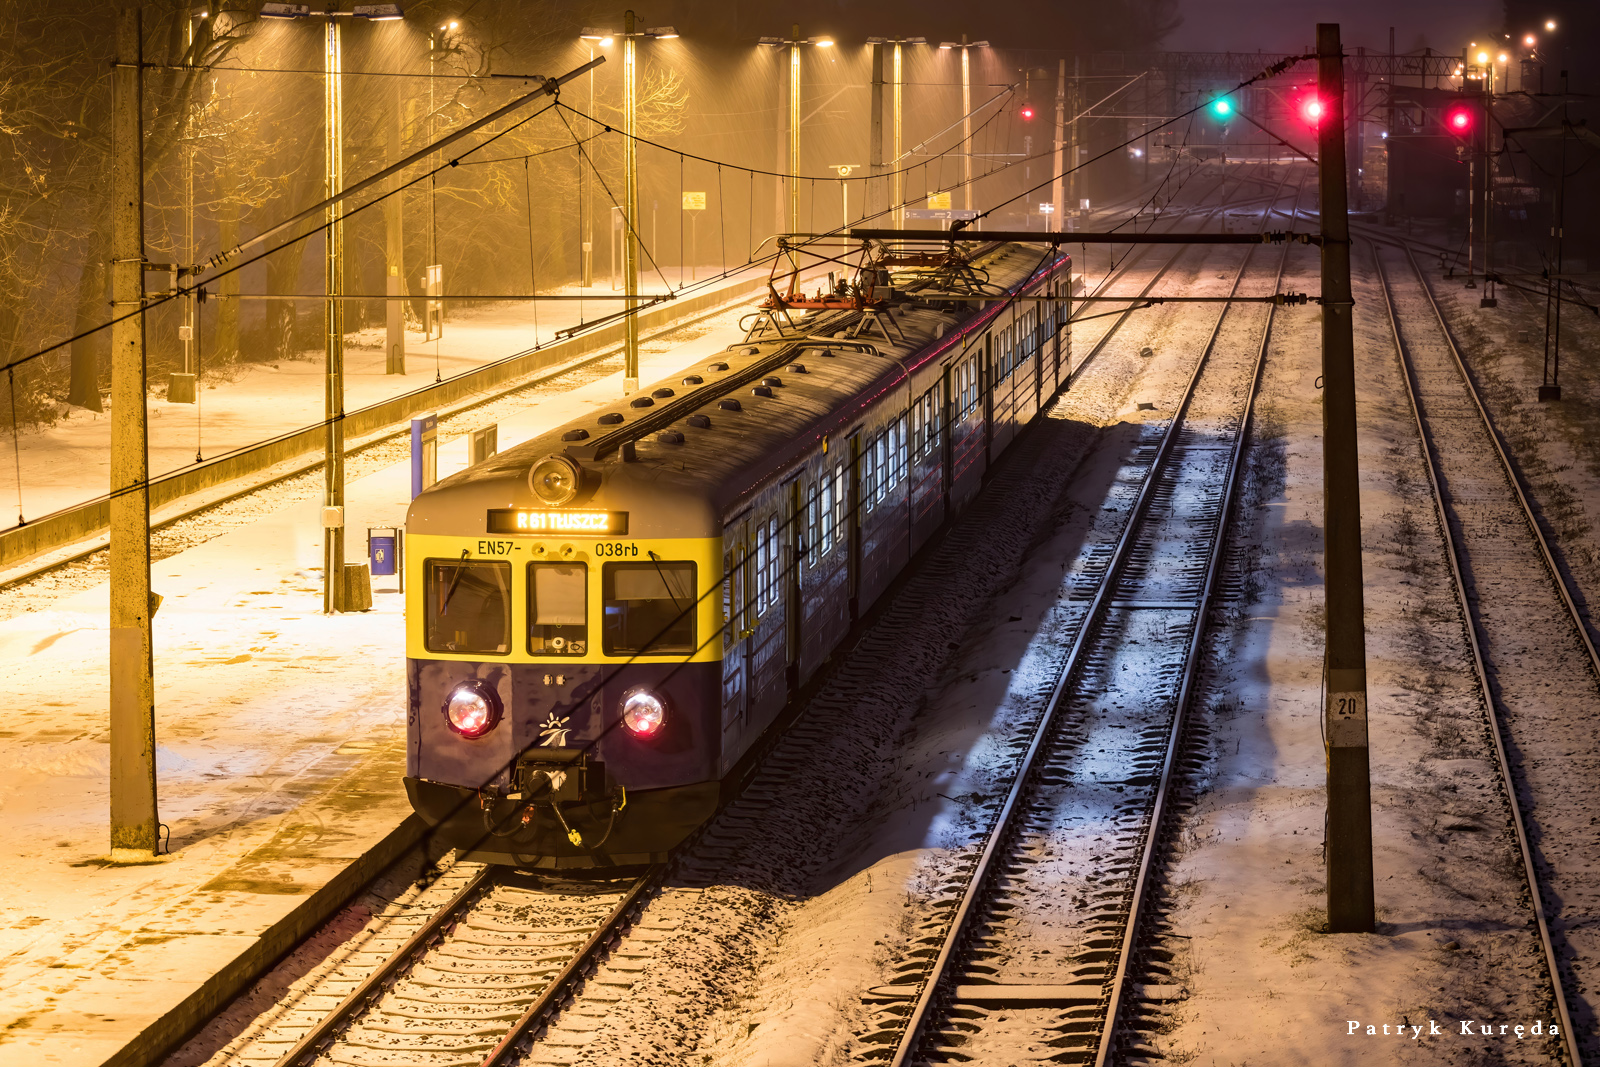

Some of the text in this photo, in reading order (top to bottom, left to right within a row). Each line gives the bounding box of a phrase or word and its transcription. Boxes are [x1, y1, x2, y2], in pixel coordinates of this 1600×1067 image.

[517, 513, 608, 529] R 61 TŁUSZCZ
[478, 541, 638, 557] EN57- 038rb
[1338, 698, 1356, 715] 20
